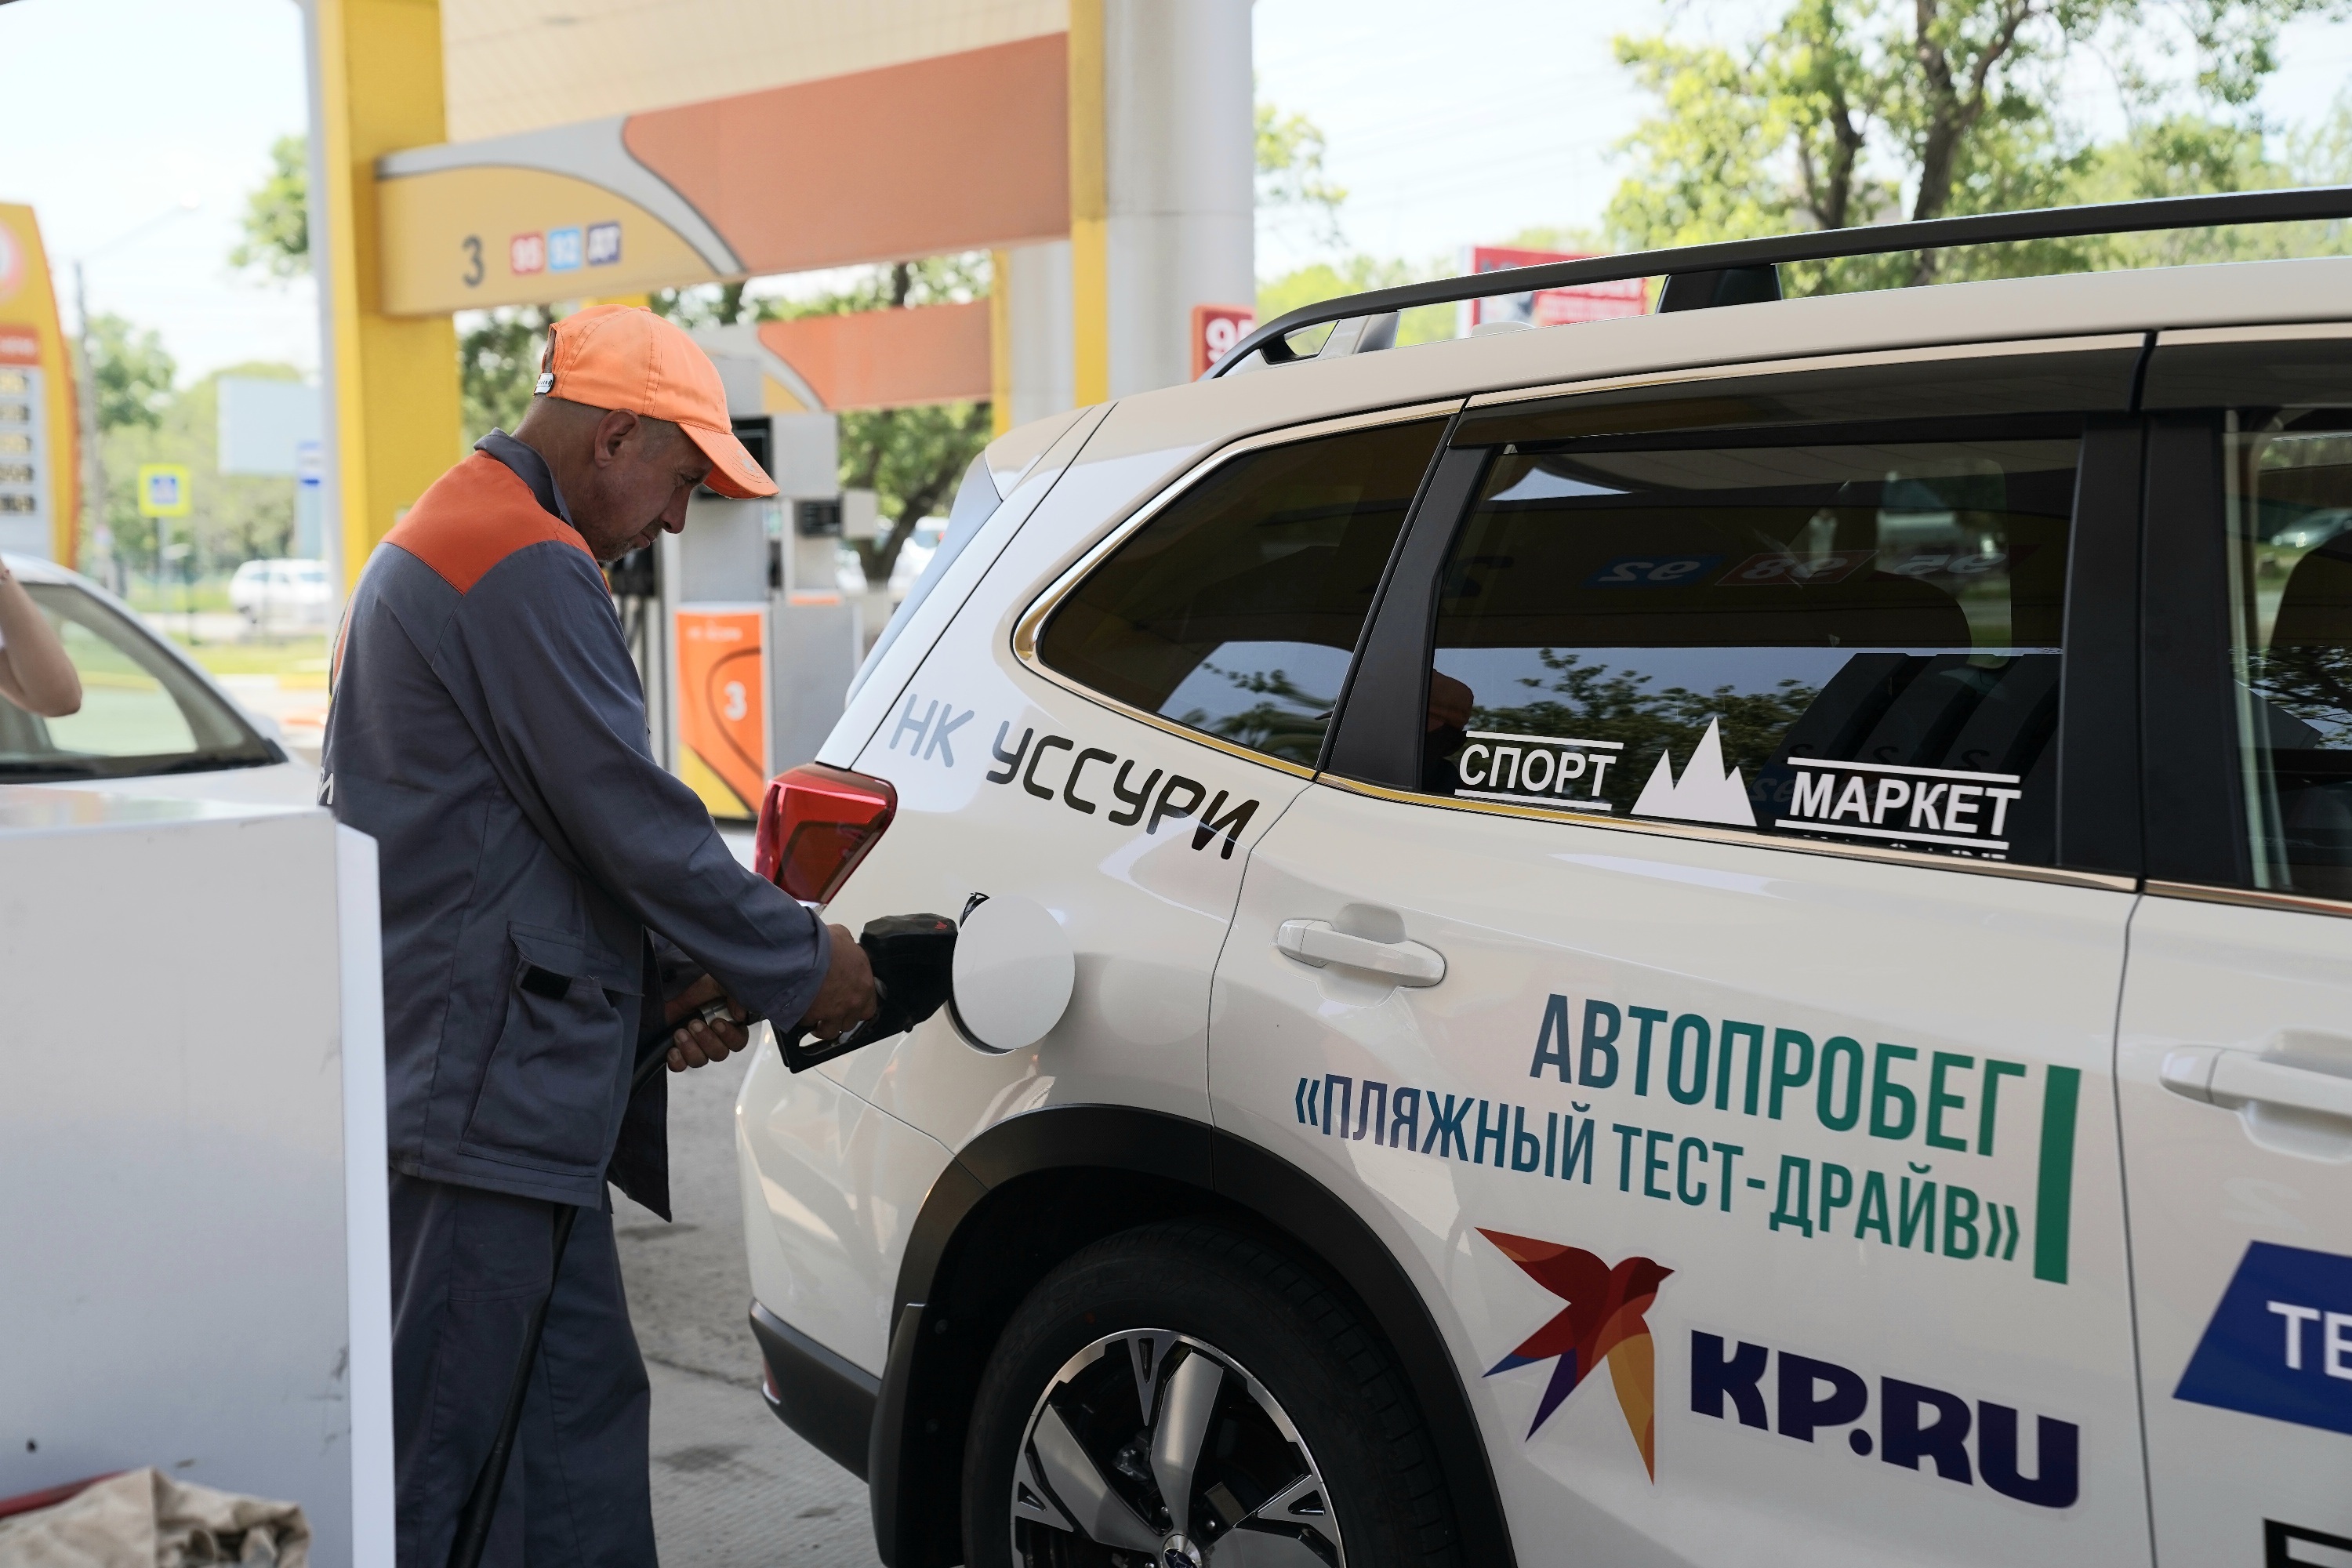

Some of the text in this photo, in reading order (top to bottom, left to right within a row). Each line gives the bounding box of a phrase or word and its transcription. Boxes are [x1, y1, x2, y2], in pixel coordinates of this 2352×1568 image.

[463, 234, 484, 288] 3
[724, 681, 747, 721] 3
[889, 693, 1260, 860] НК УССУРИ
[1459, 742, 1617, 797] СПОРТ
[1789, 771, 2022, 837] МАРКЕТ
[1530, 993, 2027, 1157] АВТОПРОБЕГ
[1295, 1073, 2020, 1263] «ПЛЯЖНЫЙ ТЕСТ-ДРАЙВ»
[1691, 1329, 2080, 1509] KP.RU
